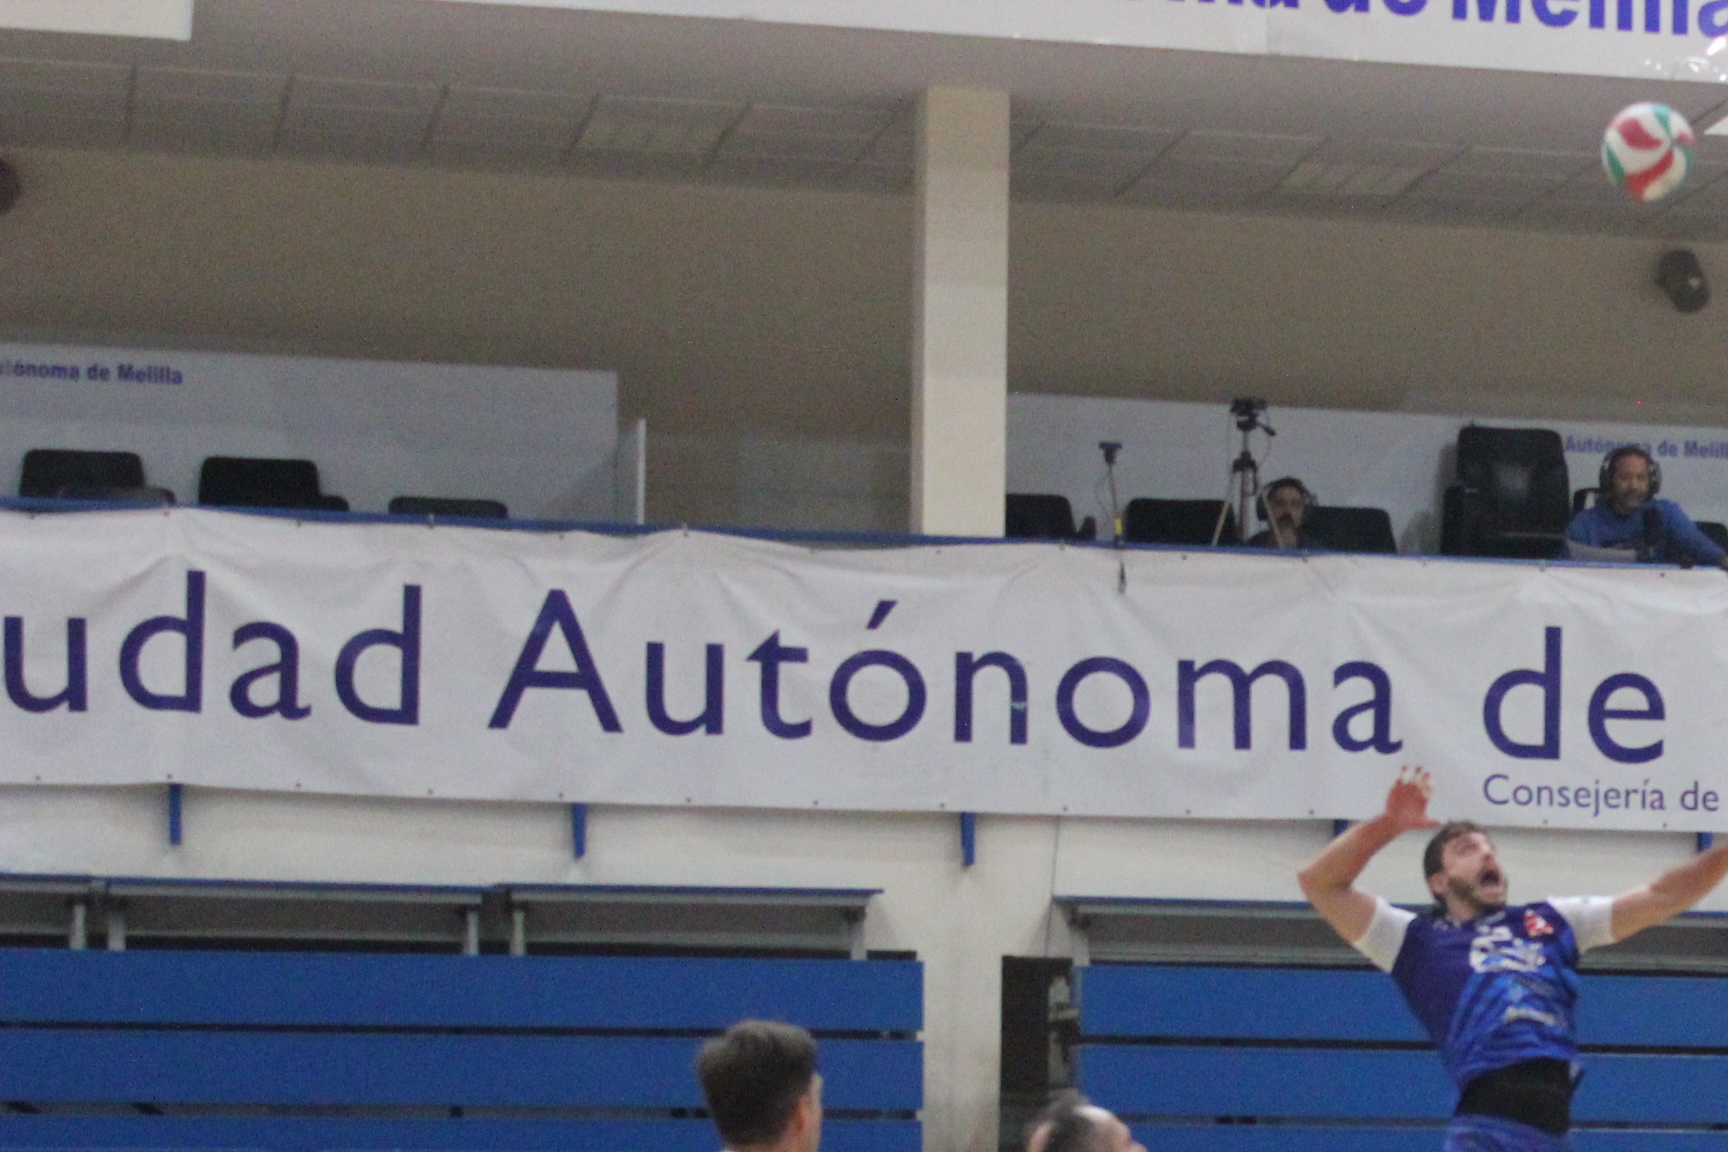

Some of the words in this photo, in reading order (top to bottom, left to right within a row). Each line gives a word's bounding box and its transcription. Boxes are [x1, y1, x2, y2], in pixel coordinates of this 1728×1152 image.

[87, 363, 110, 381] de
[117, 363, 182, 385] Melilla
[488, 588, 1404, 755] Autónoma
[1483, 626, 1666, 764] de
[1483, 772, 1665, 816] Consejería
[1681, 778, 1720, 813] de
